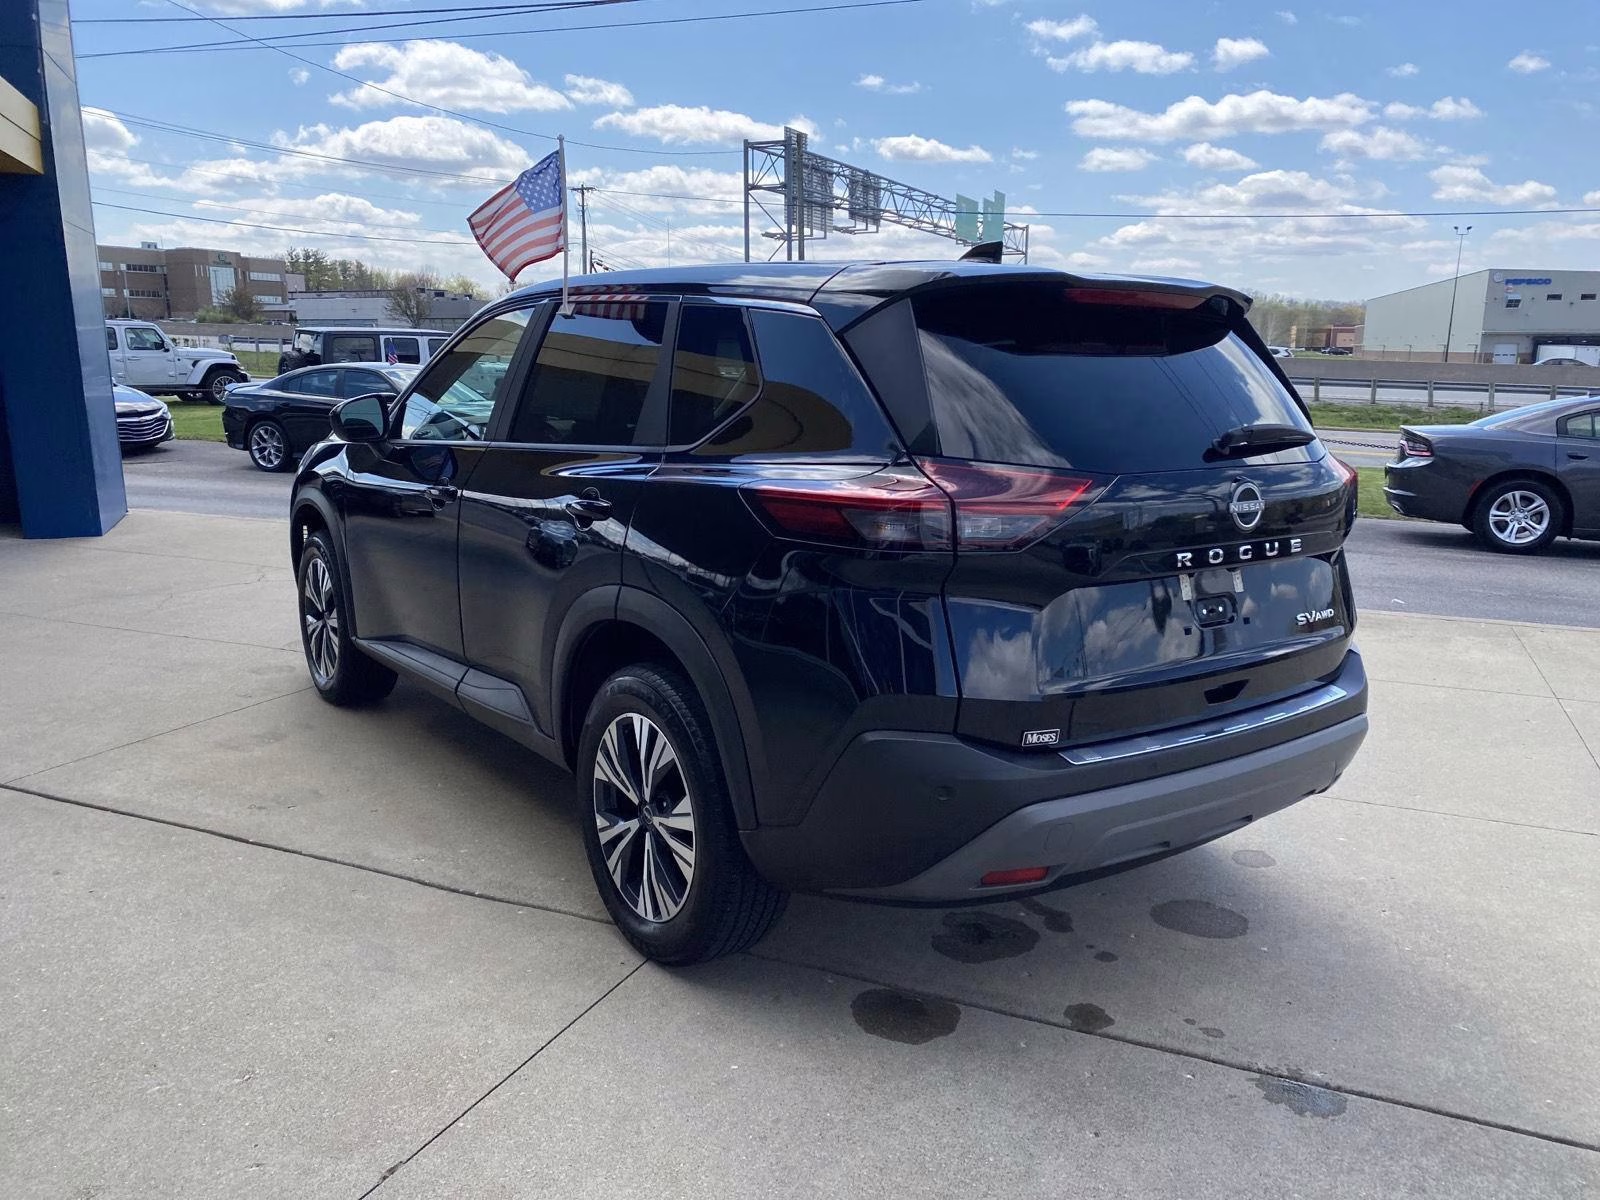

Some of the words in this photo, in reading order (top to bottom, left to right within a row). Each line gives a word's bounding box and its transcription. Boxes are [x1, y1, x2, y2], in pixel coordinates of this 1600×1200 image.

[1230, 502, 1264, 512] NISSAN
[1176, 538, 1302, 567] ROGUE
[1026, 732, 1056, 744] MOSES
